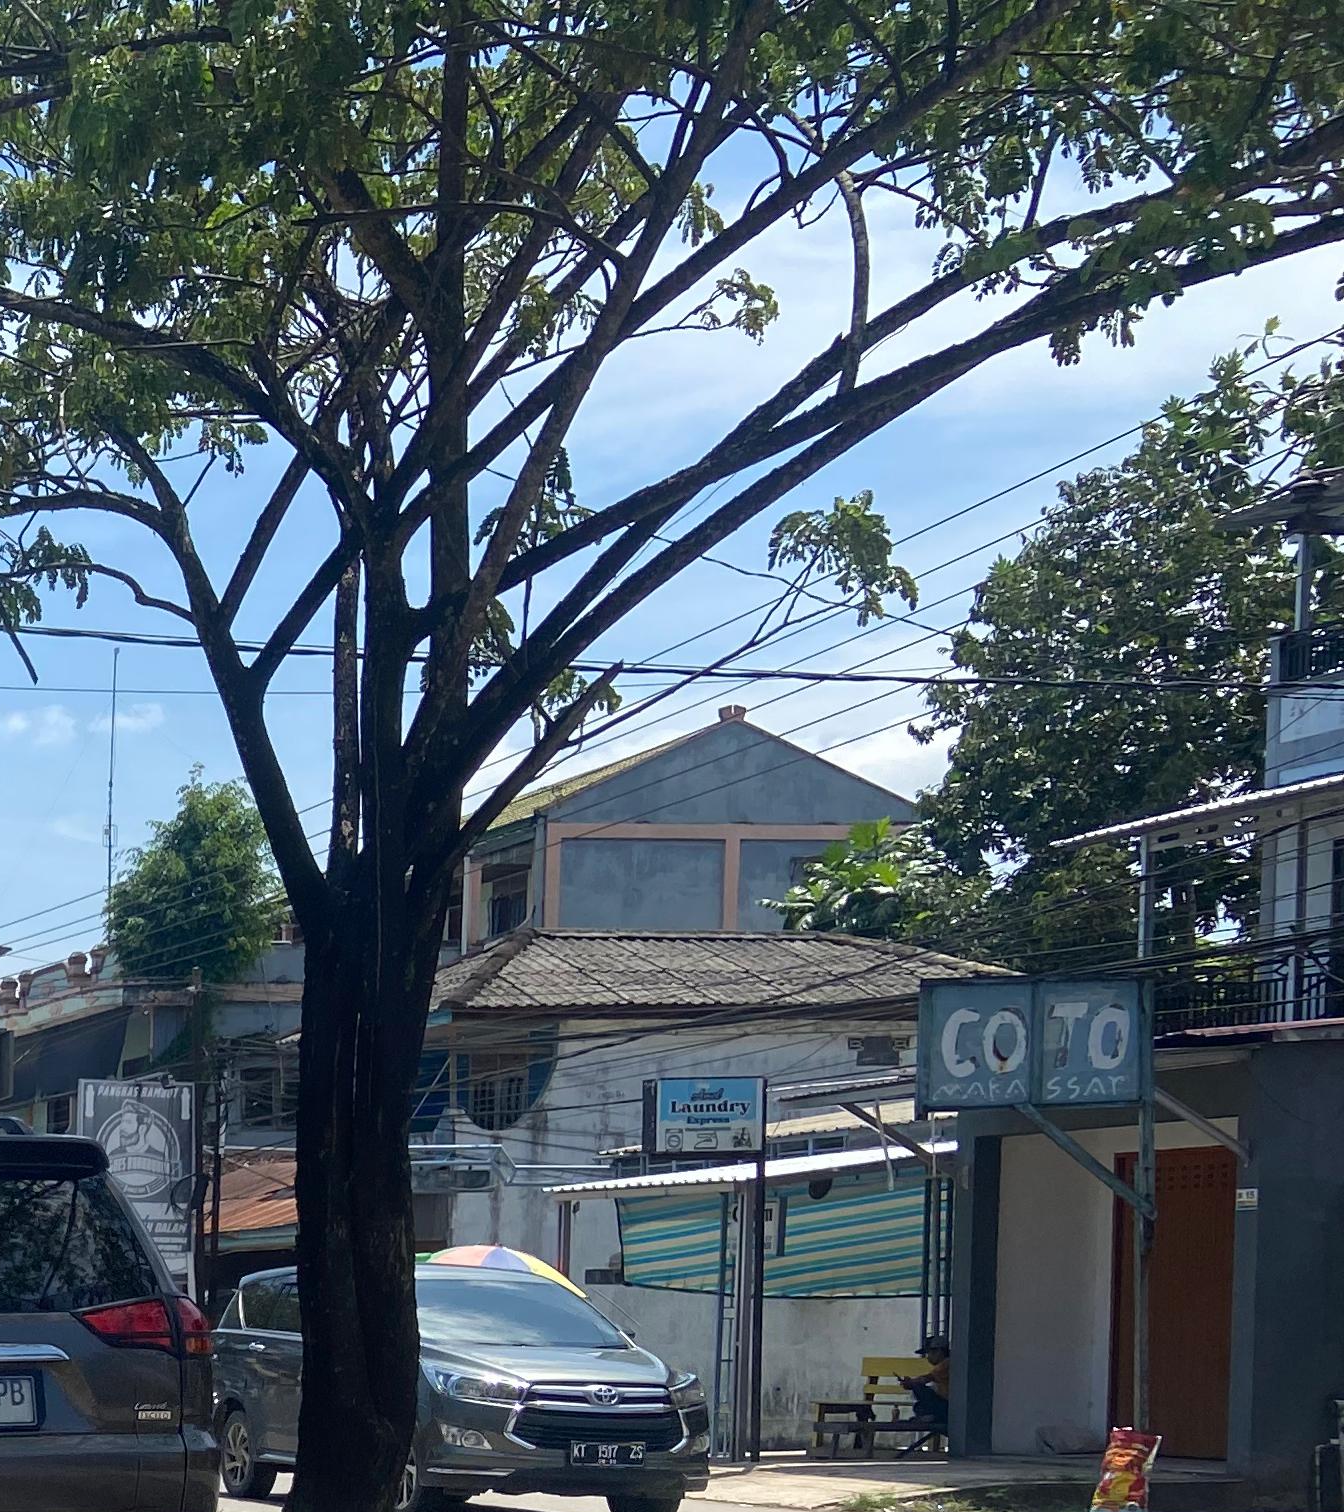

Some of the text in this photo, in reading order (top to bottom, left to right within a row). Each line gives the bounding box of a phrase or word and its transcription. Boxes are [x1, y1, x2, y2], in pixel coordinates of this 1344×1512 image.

[941, 1002, 1130, 1078] COTO
[671, 1100, 750, 1115] Laundry
[573, 1444, 643, 1459] KT 1517 ZS
